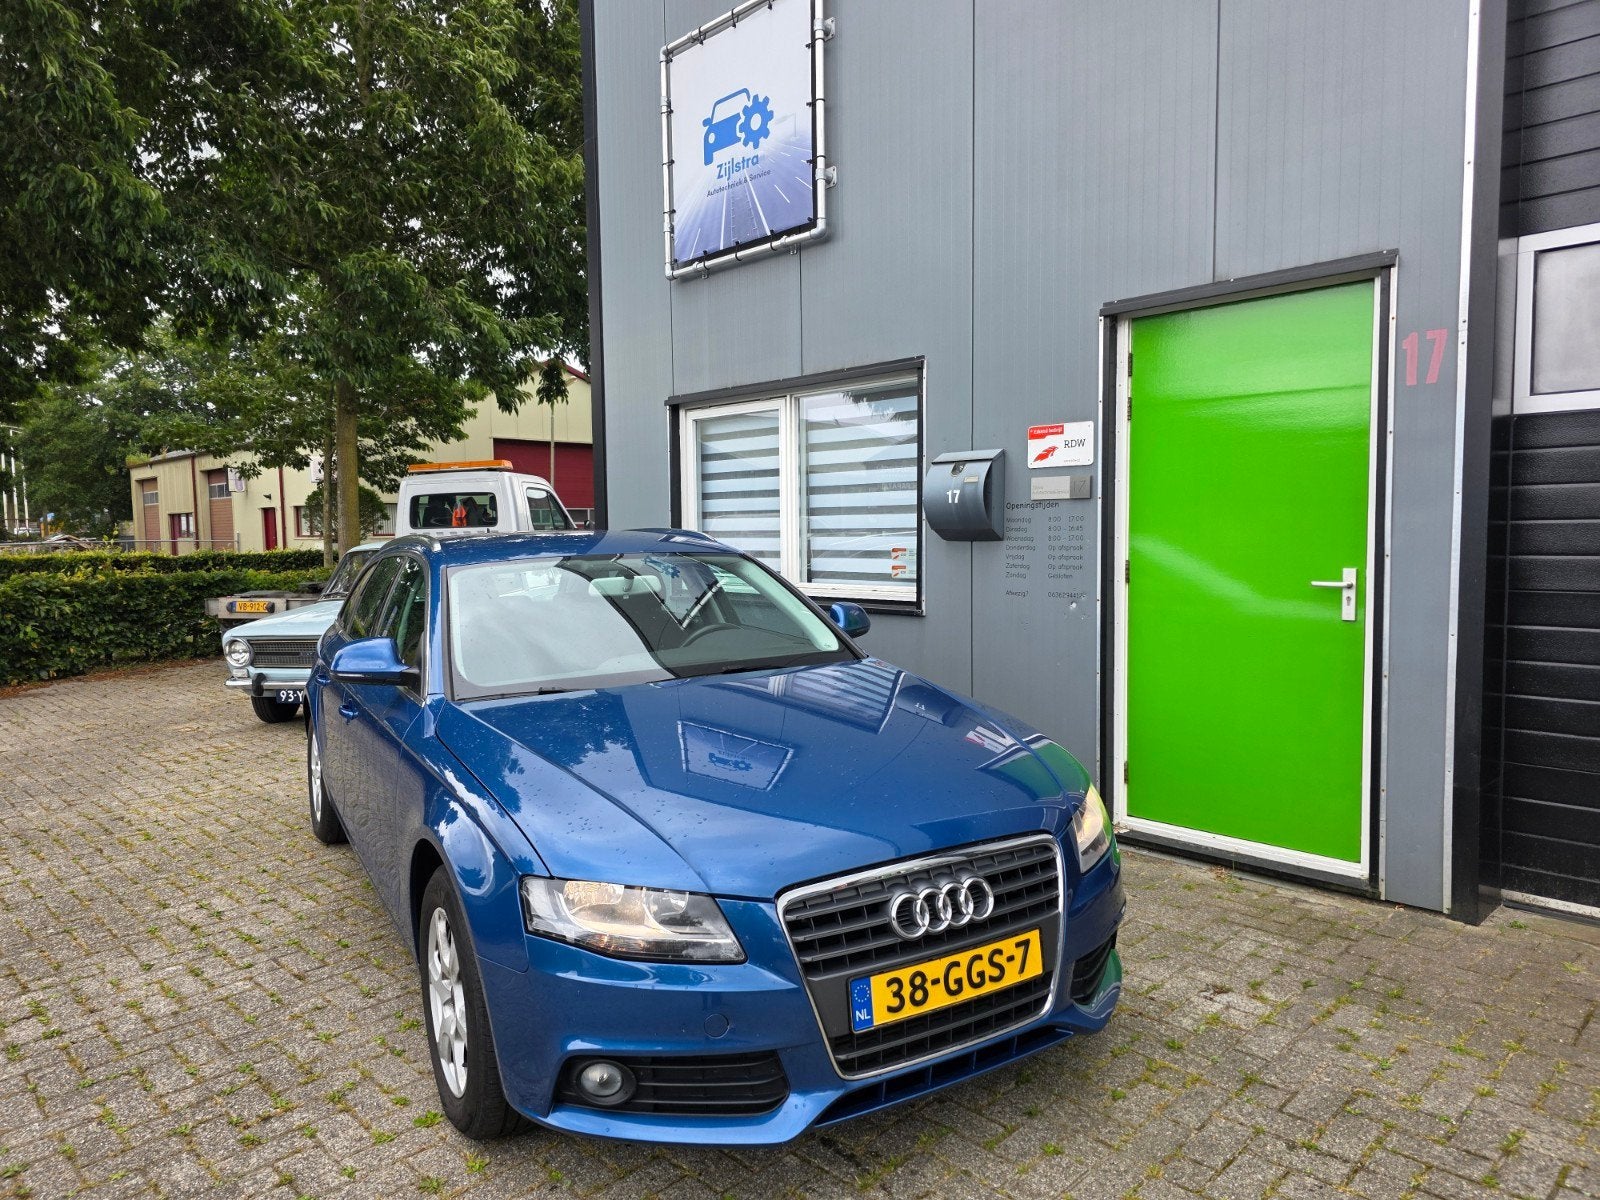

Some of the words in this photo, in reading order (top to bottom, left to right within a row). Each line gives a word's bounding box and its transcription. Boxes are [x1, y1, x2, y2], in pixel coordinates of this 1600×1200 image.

[716, 154, 759, 181] Zijlstra
[707, 178, 743, 197] Autotechniek
[749, 169, 771, 182] Service
[1402, 328, 1449, 386] 17
[1063, 438, 1086, 448] RDW
[946, 489, 960, 504] 17
[1005, 501, 1060, 511] Openingstijden
[886, 938, 1031, 1014] 38-GGS-7
[855, 1009, 871, 1022] NL
